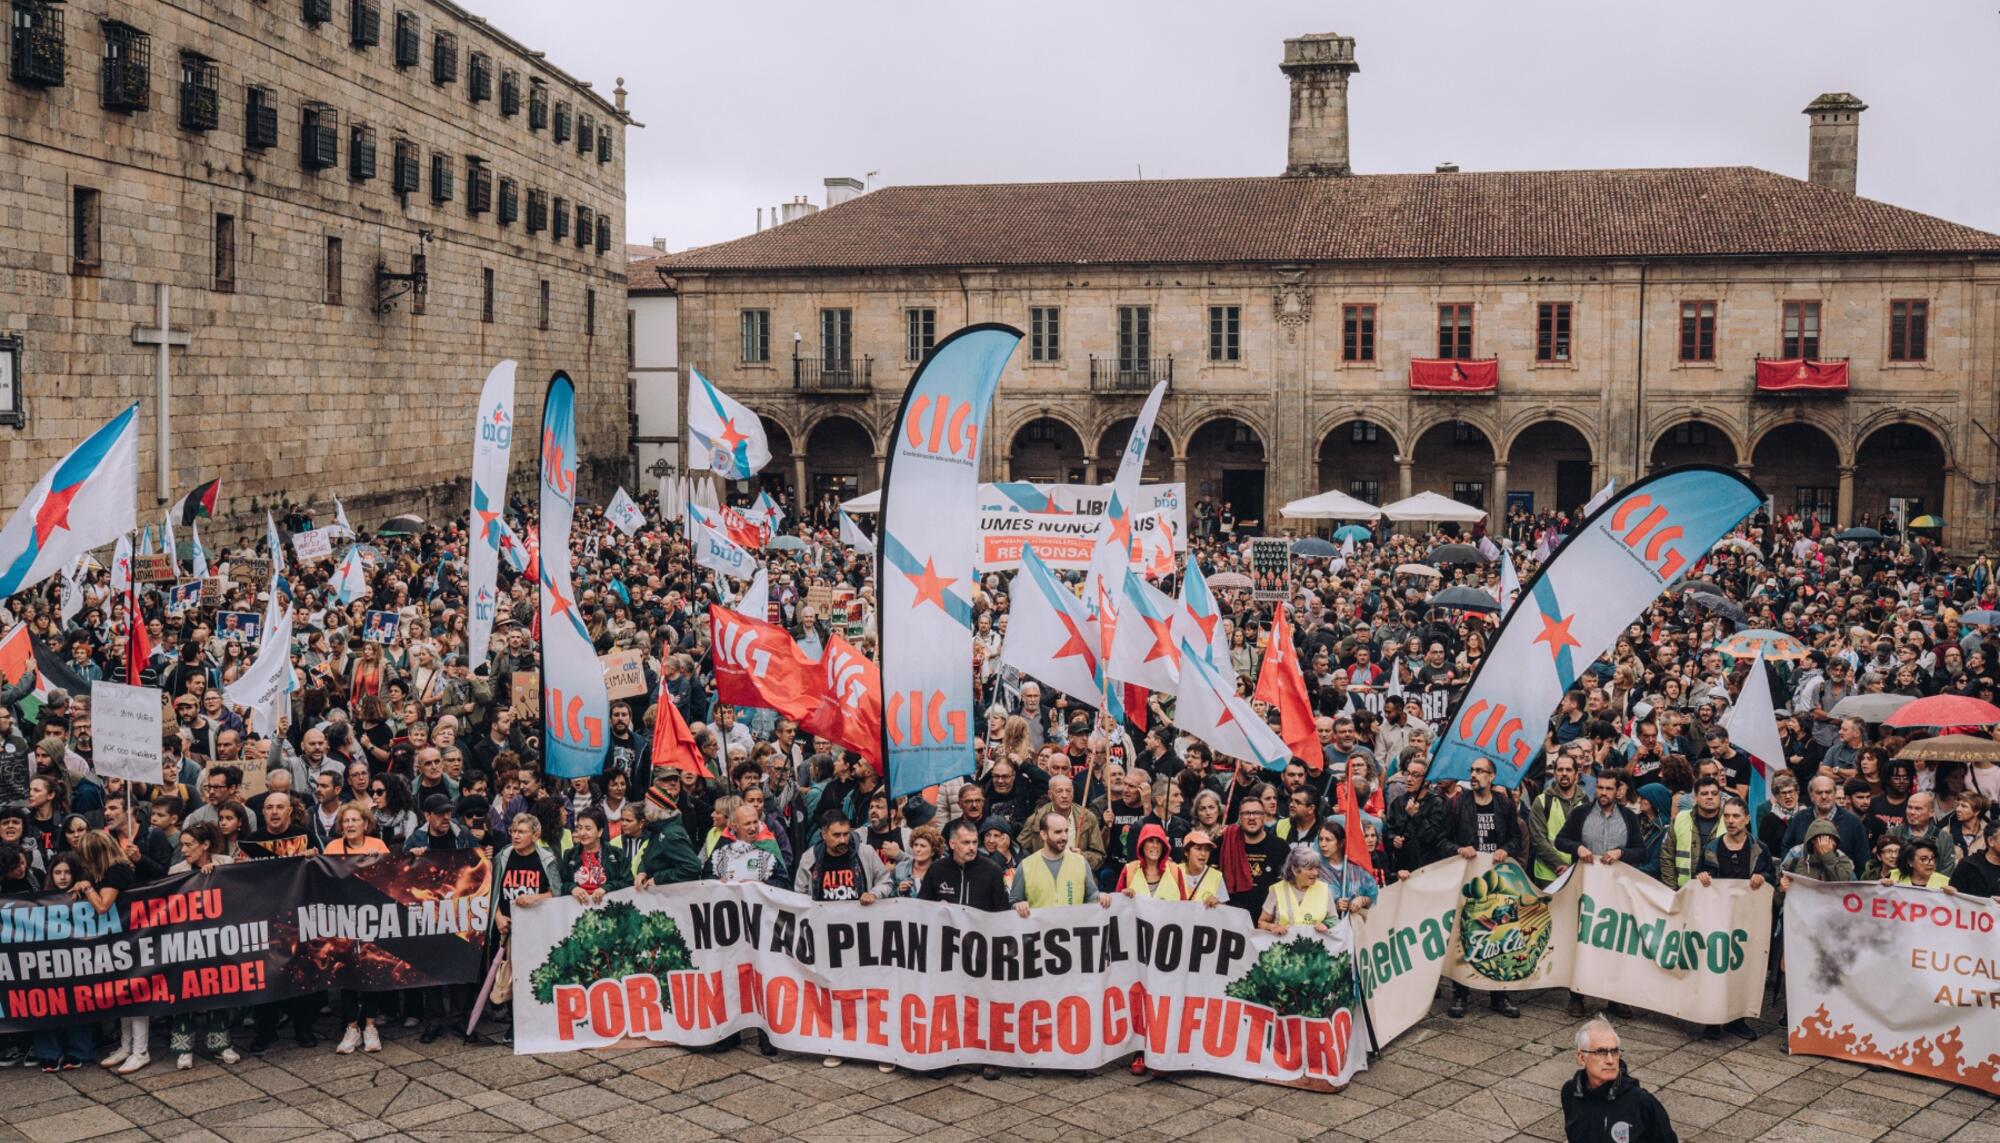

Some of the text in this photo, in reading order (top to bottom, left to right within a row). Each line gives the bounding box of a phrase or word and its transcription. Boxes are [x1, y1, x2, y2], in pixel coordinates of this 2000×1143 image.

[905, 392, 978, 460] CIG
[981, 518, 1034, 530] UMES
[1153, 496, 1178, 509] bng
[709, 538, 743, 567] bng
[998, 546, 1093, 559] RESPONSA
[1610, 494, 1686, 581] CIG
[714, 618, 771, 678] CIG
[887, 689, 967, 747] CIG
[1458, 698, 1532, 768] CIG
[503, 870, 540, 888] ALTRI
[823, 885, 859, 900] NON
[129, 888, 223, 930] ARDEU
[1577, 893, 1748, 974] Gandeiros
[1843, 893, 1995, 934] O EXPOLIO
[18, 940, 134, 981] PEDRAS
[138, 936, 155, 967] E
[161, 919, 270, 964] MATO!!!
[689, 899, 1246, 982] NON AO PLAN FORESTAL DO PP
[1911, 948, 2000, 981] EUCAL
[8, 986, 69, 1018] NON
[73, 973, 176, 1014] RUEDA,
[182, 960, 266, 1000] ARDE!
[554, 974, 664, 1041] POR
[668, 969, 728, 1031] UN
[900, 993, 1091, 1056] GALEGO
[1103, 980, 1171, 1055] CON
[1177, 994, 1352, 1078] FUTURO
